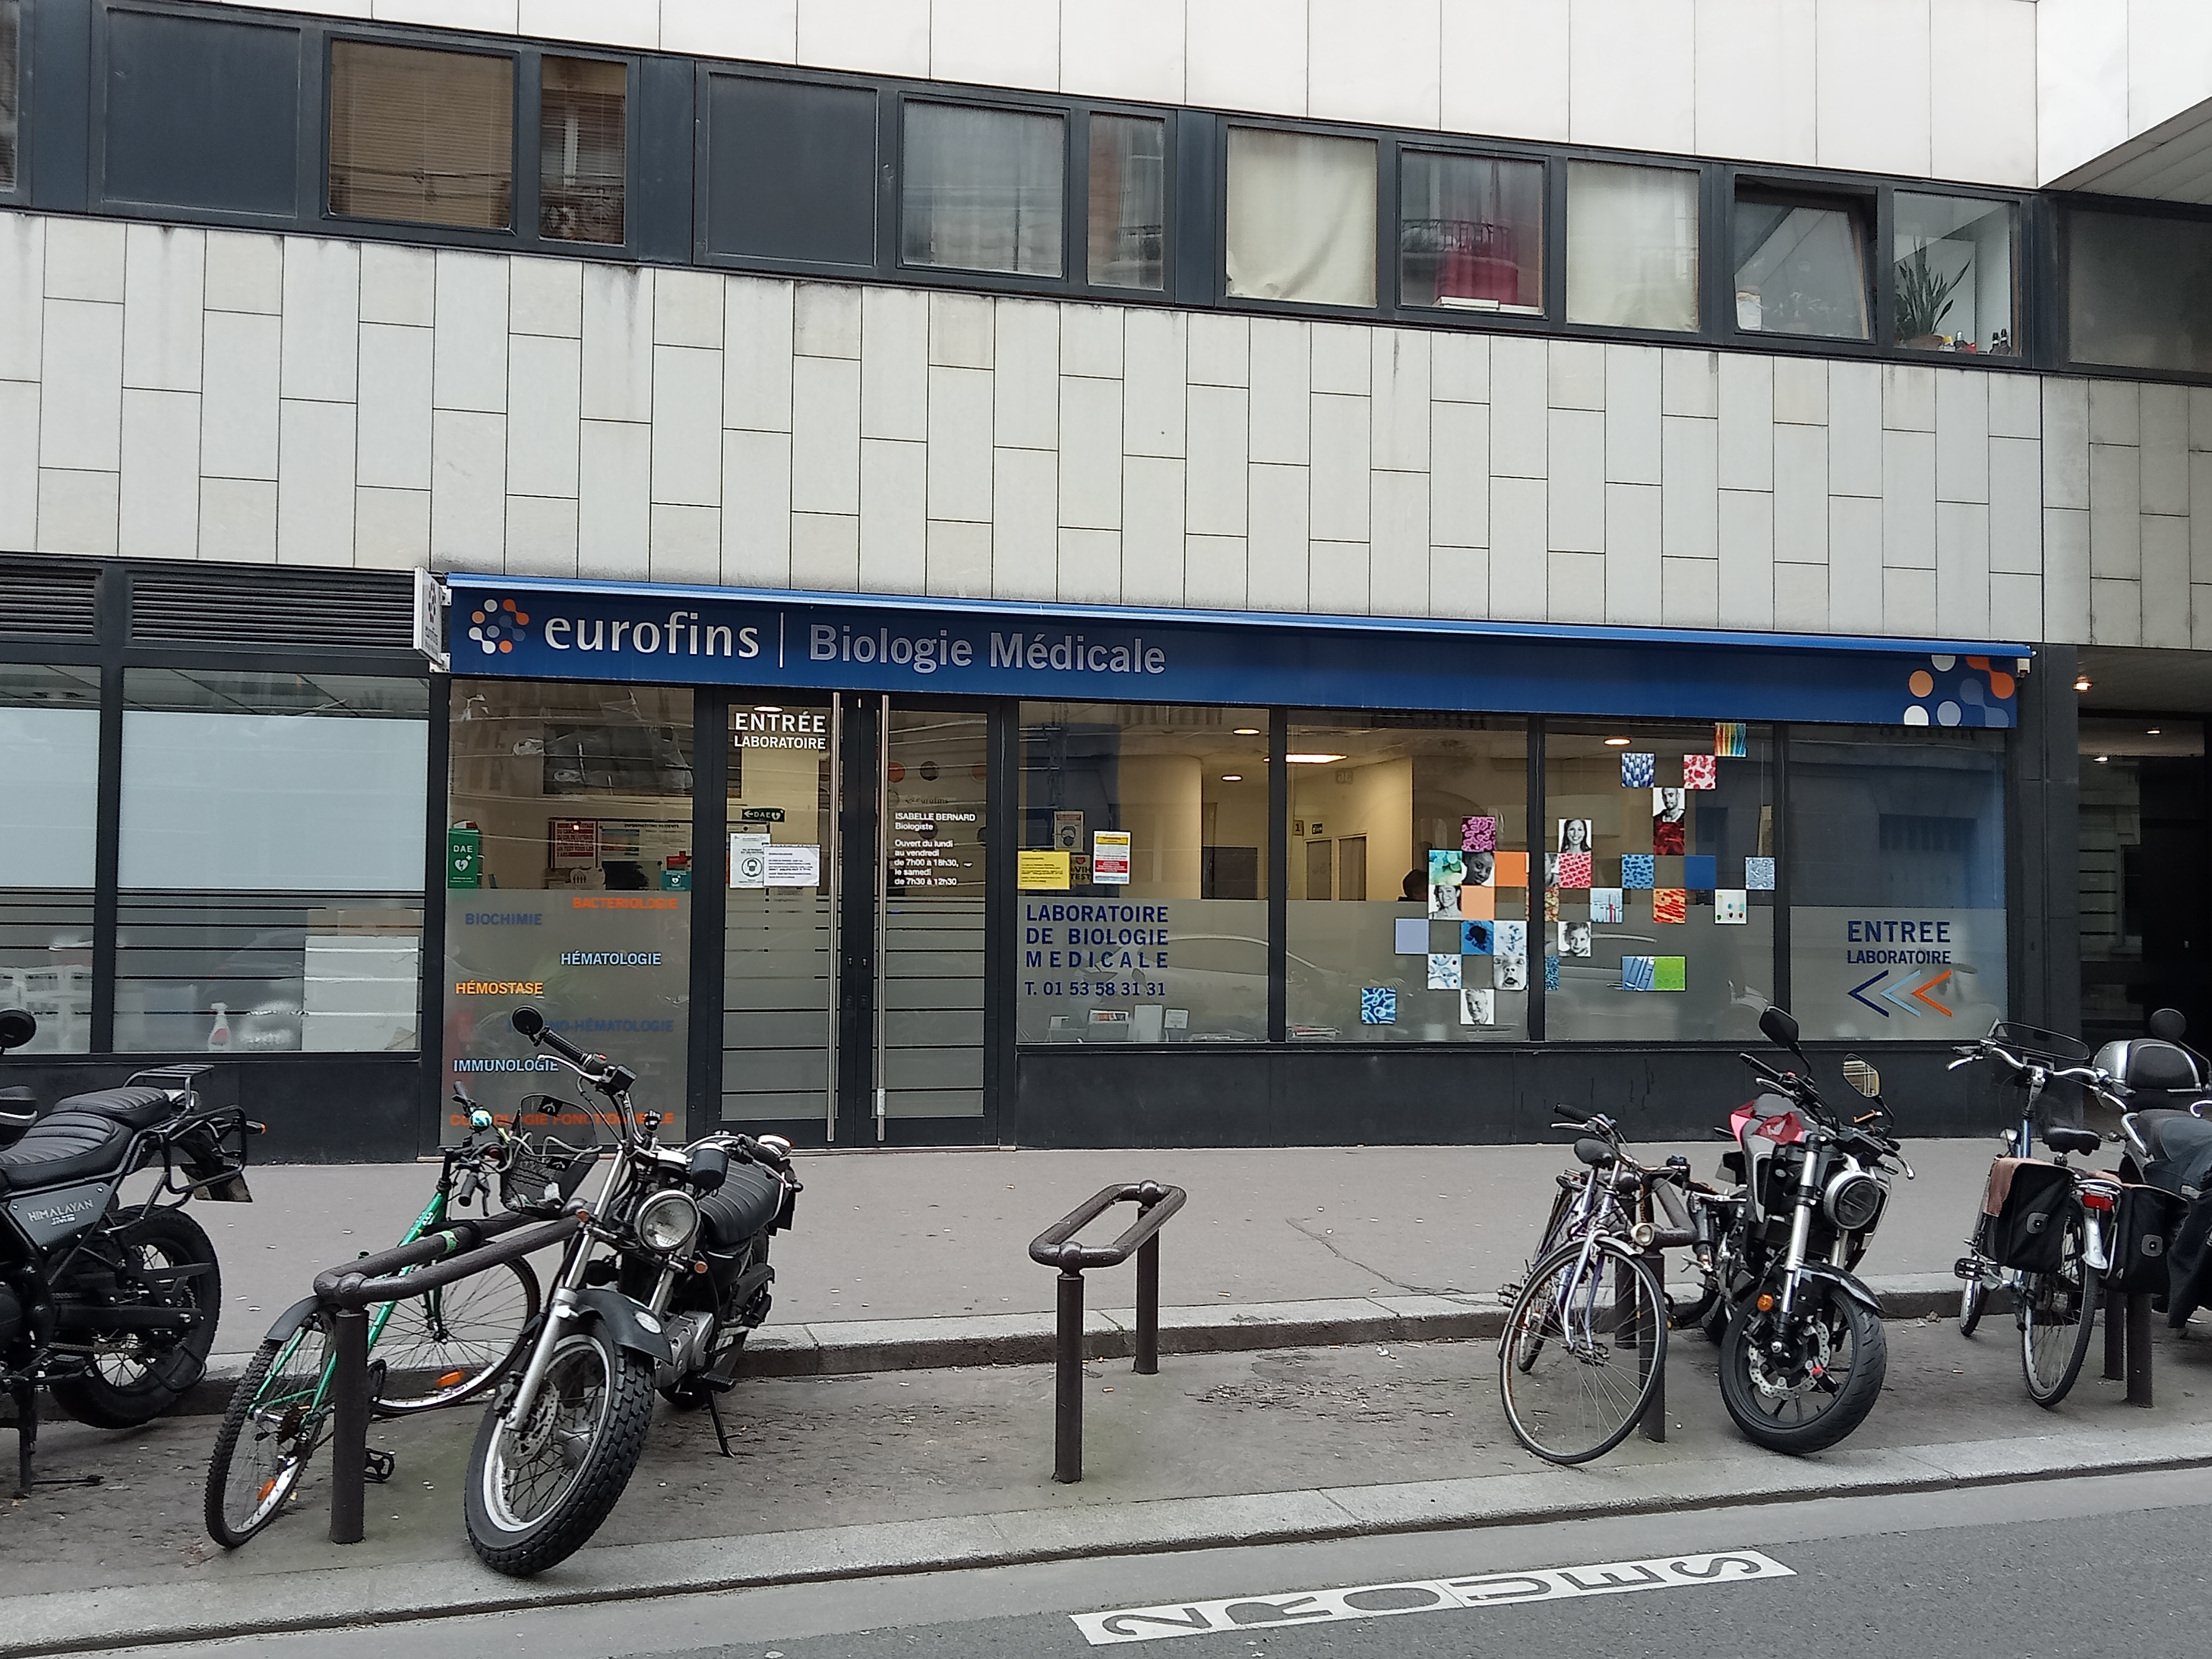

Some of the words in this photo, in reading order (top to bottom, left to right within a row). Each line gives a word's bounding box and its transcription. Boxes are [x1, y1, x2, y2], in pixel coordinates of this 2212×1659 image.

[544, 611, 759, 658] eurofins
[810, 624, 973, 673] Biologie
[990, 632, 1166, 673] Médicale
[735, 711, 826, 733] ENTRÉE
[734, 735, 826, 749] LABORATOIRE
[895, 823, 933, 831] Biologiste
[465, 913, 542, 925] BIOCHIMIE
[1027, 904, 1168, 923] LABORATOIRE
[1026, 928, 1053, 944] DE
[1069, 928, 1169, 945] BIOLOGIE
[1847, 920, 1950, 943] ENTREE
[560, 950, 662, 966] HÉMATOLOGIE
[1026, 951, 1168, 968] MEDICALE
[1847, 950, 1951, 965] LABORATOIRE
[455, 980, 543, 995] HÉMOSTASE
[1025, 982, 1037, 996] T.
[1043, 982, 1062, 996] 01
[1070, 982, 1089, 996] 53
[1095, 982, 1116, 996] 58
[1121, 982, 1140, 996] 31
[1146, 982, 1166, 996] 31
[454, 1059, 559, 1073] IMMUNOLOGIE
[27, 1199, 95, 1222] HIMALAYAN
